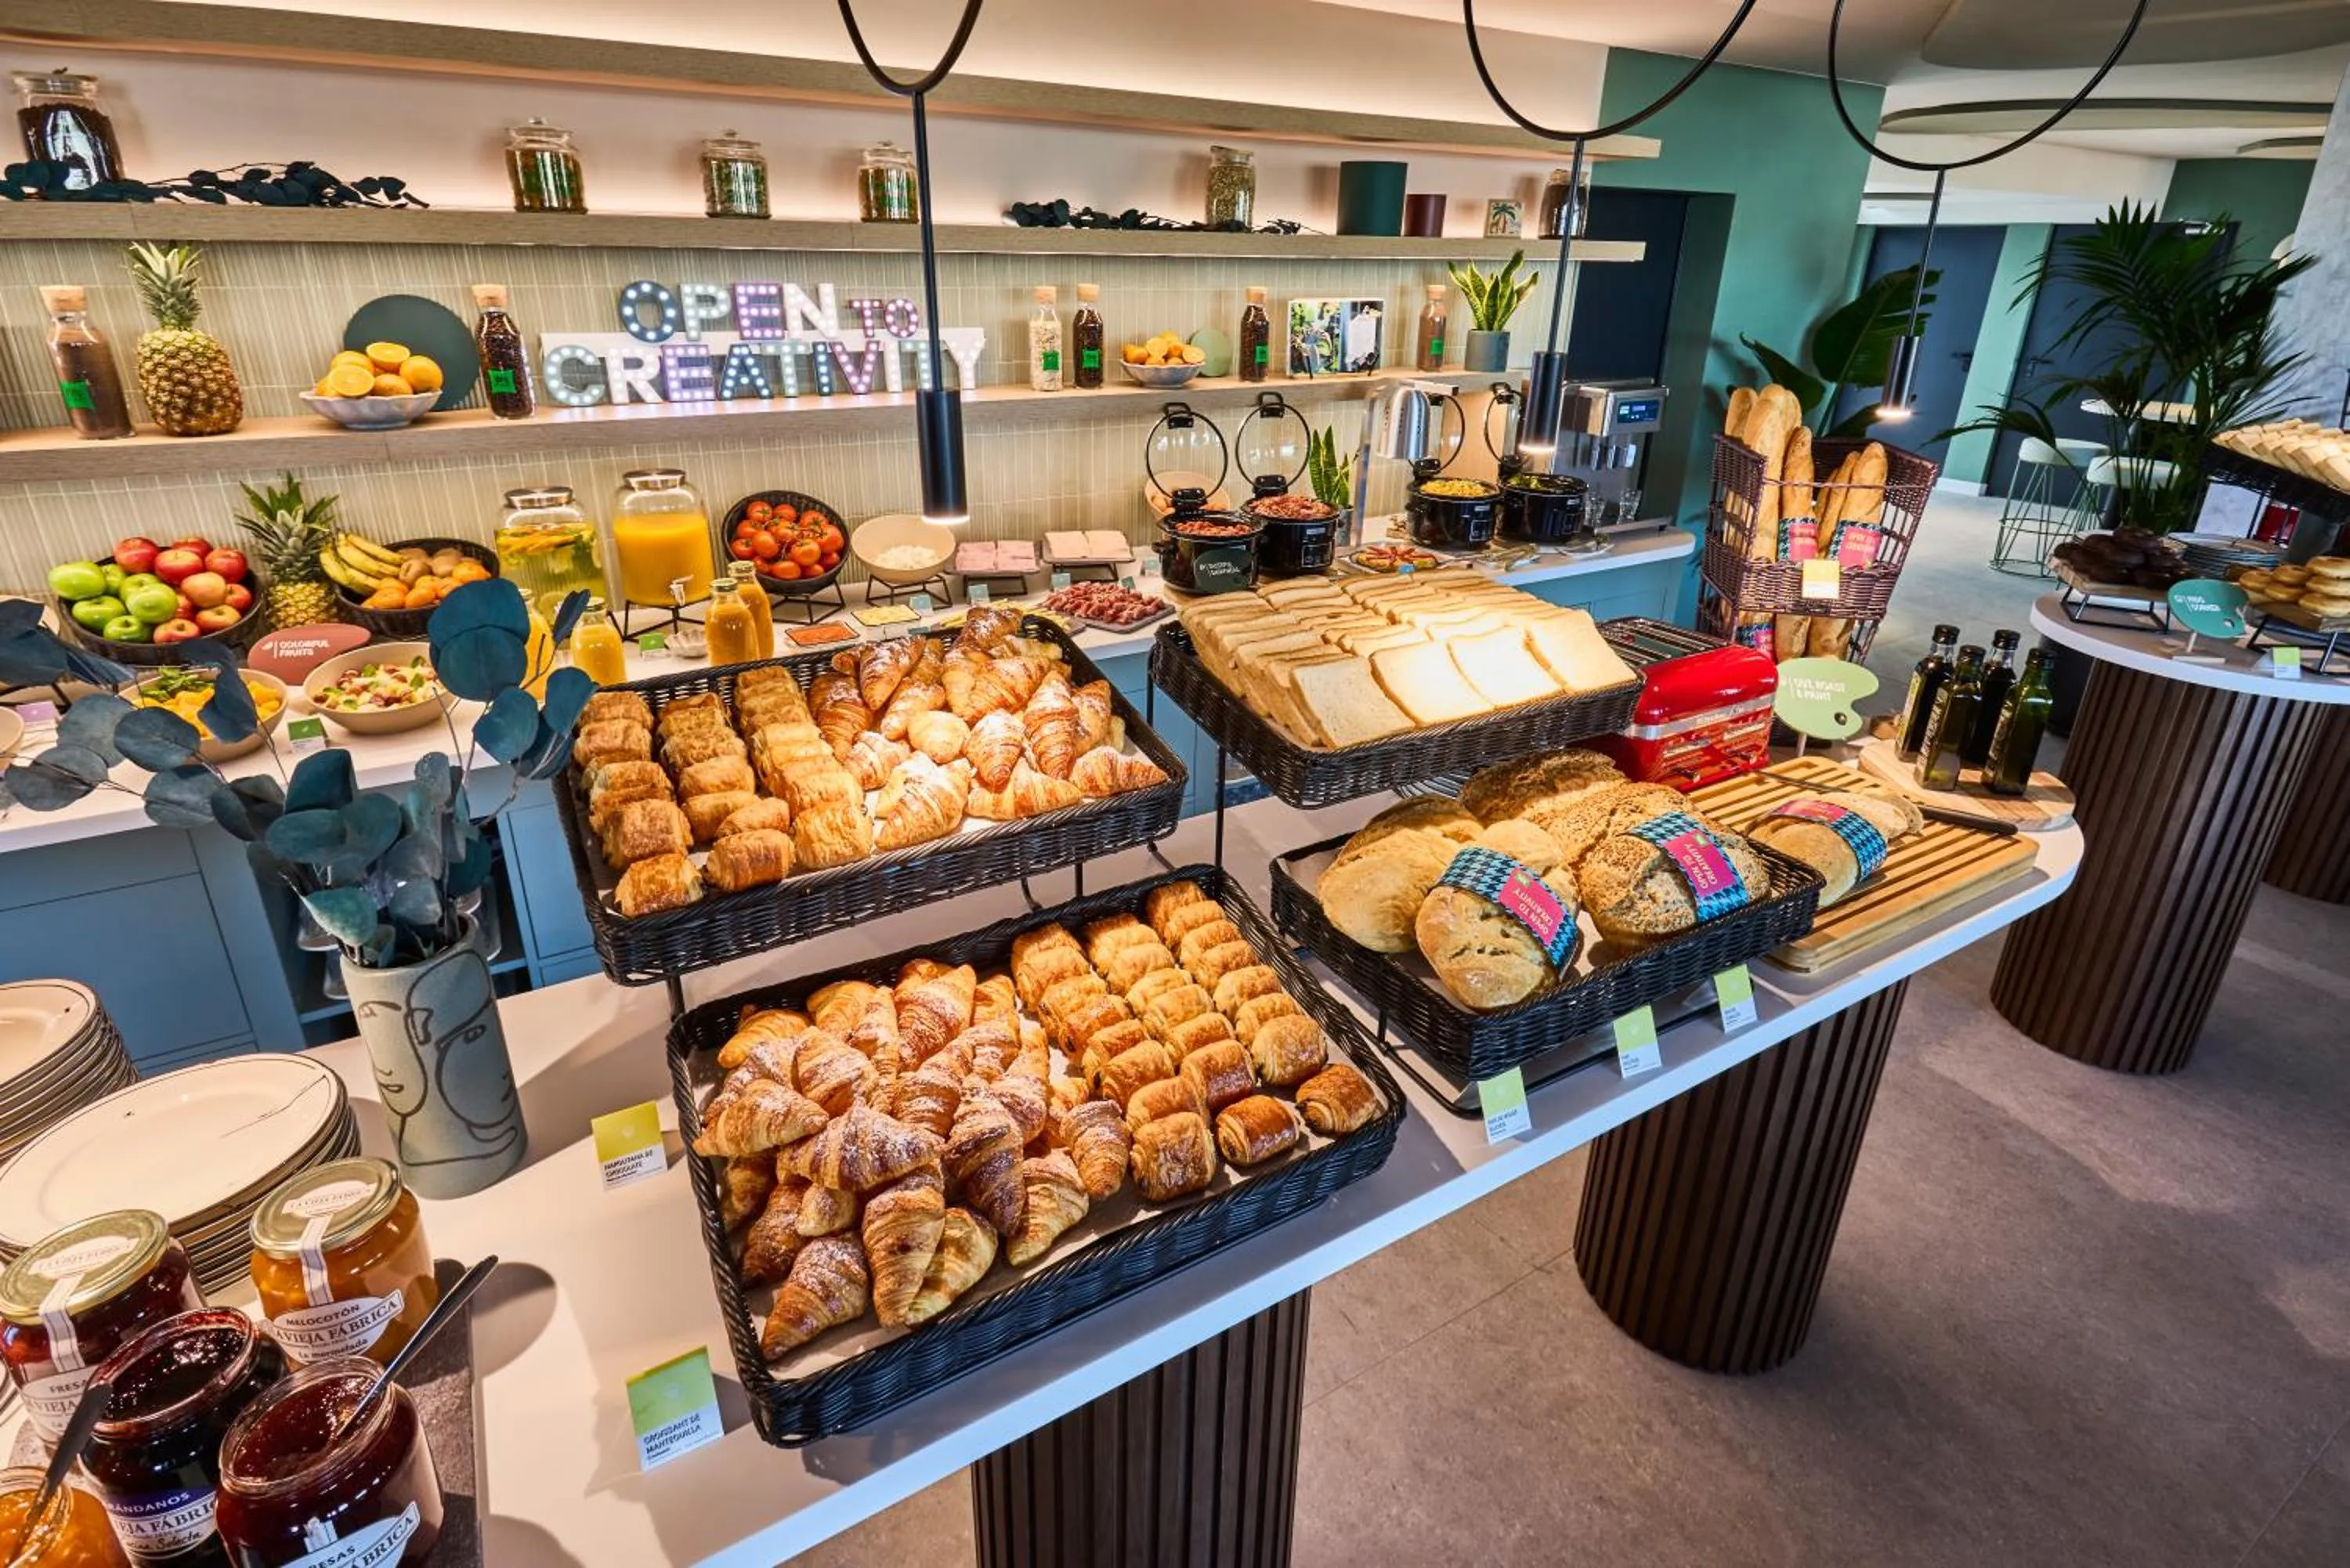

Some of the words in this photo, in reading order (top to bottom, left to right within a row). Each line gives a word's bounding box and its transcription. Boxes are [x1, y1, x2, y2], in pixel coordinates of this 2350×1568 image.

[619, 280, 839, 342] OPEN
[848, 298, 919, 339] TO
[544, 339, 986, 406] CREATIVITY
[279, 639, 330, 649] COLORFUL
[279, 648, 314, 657] FRUITS
[1684, 843, 1718, 885] CREATIVITY
[1691, 866, 1708, 890] OPEN
[1513, 888, 1554, 927] CREATIVITY
[1529, 913, 1549, 935] OPEN
[283, 1331, 324, 1346] VIEJA
[328, 1300, 398, 1340] FÁBRICA
[286, 1303, 360, 1326] MELOCOTÓN
[645, 1423, 702, 1454] MANTEQUILLA
[150, 1496, 216, 1533] FÁBRIC
